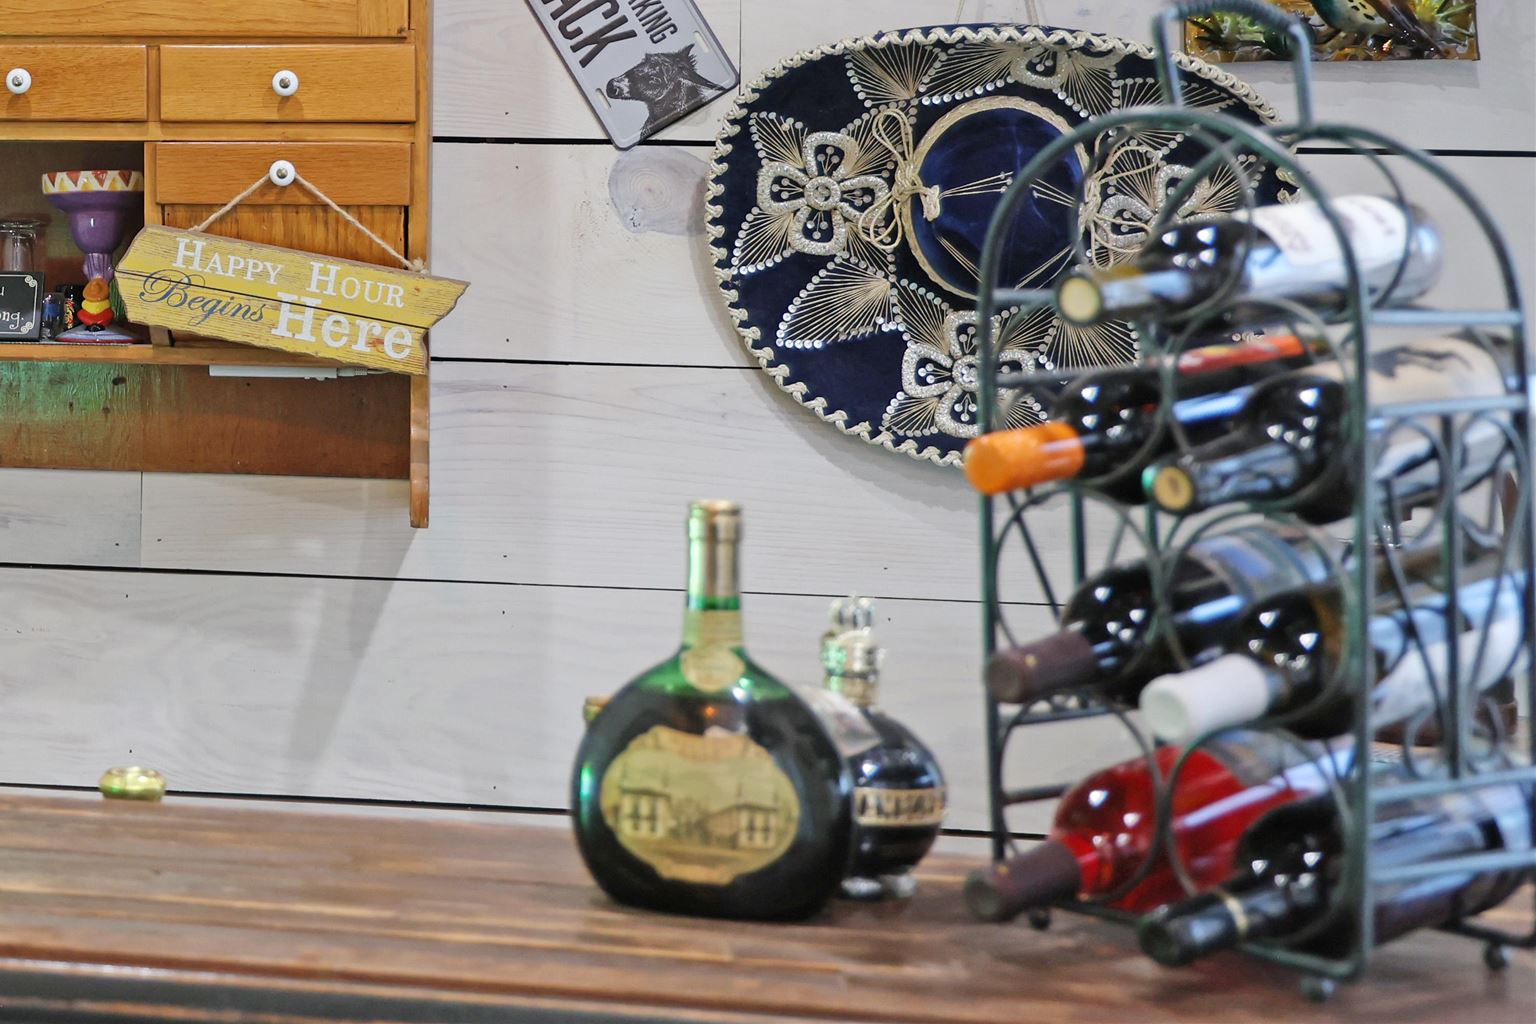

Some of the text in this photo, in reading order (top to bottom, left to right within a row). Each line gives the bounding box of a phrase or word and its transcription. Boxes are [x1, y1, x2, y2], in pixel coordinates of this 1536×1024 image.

[172, 236, 406, 308] HAPPY HOUR
[139, 269, 414, 359] Begins Here
